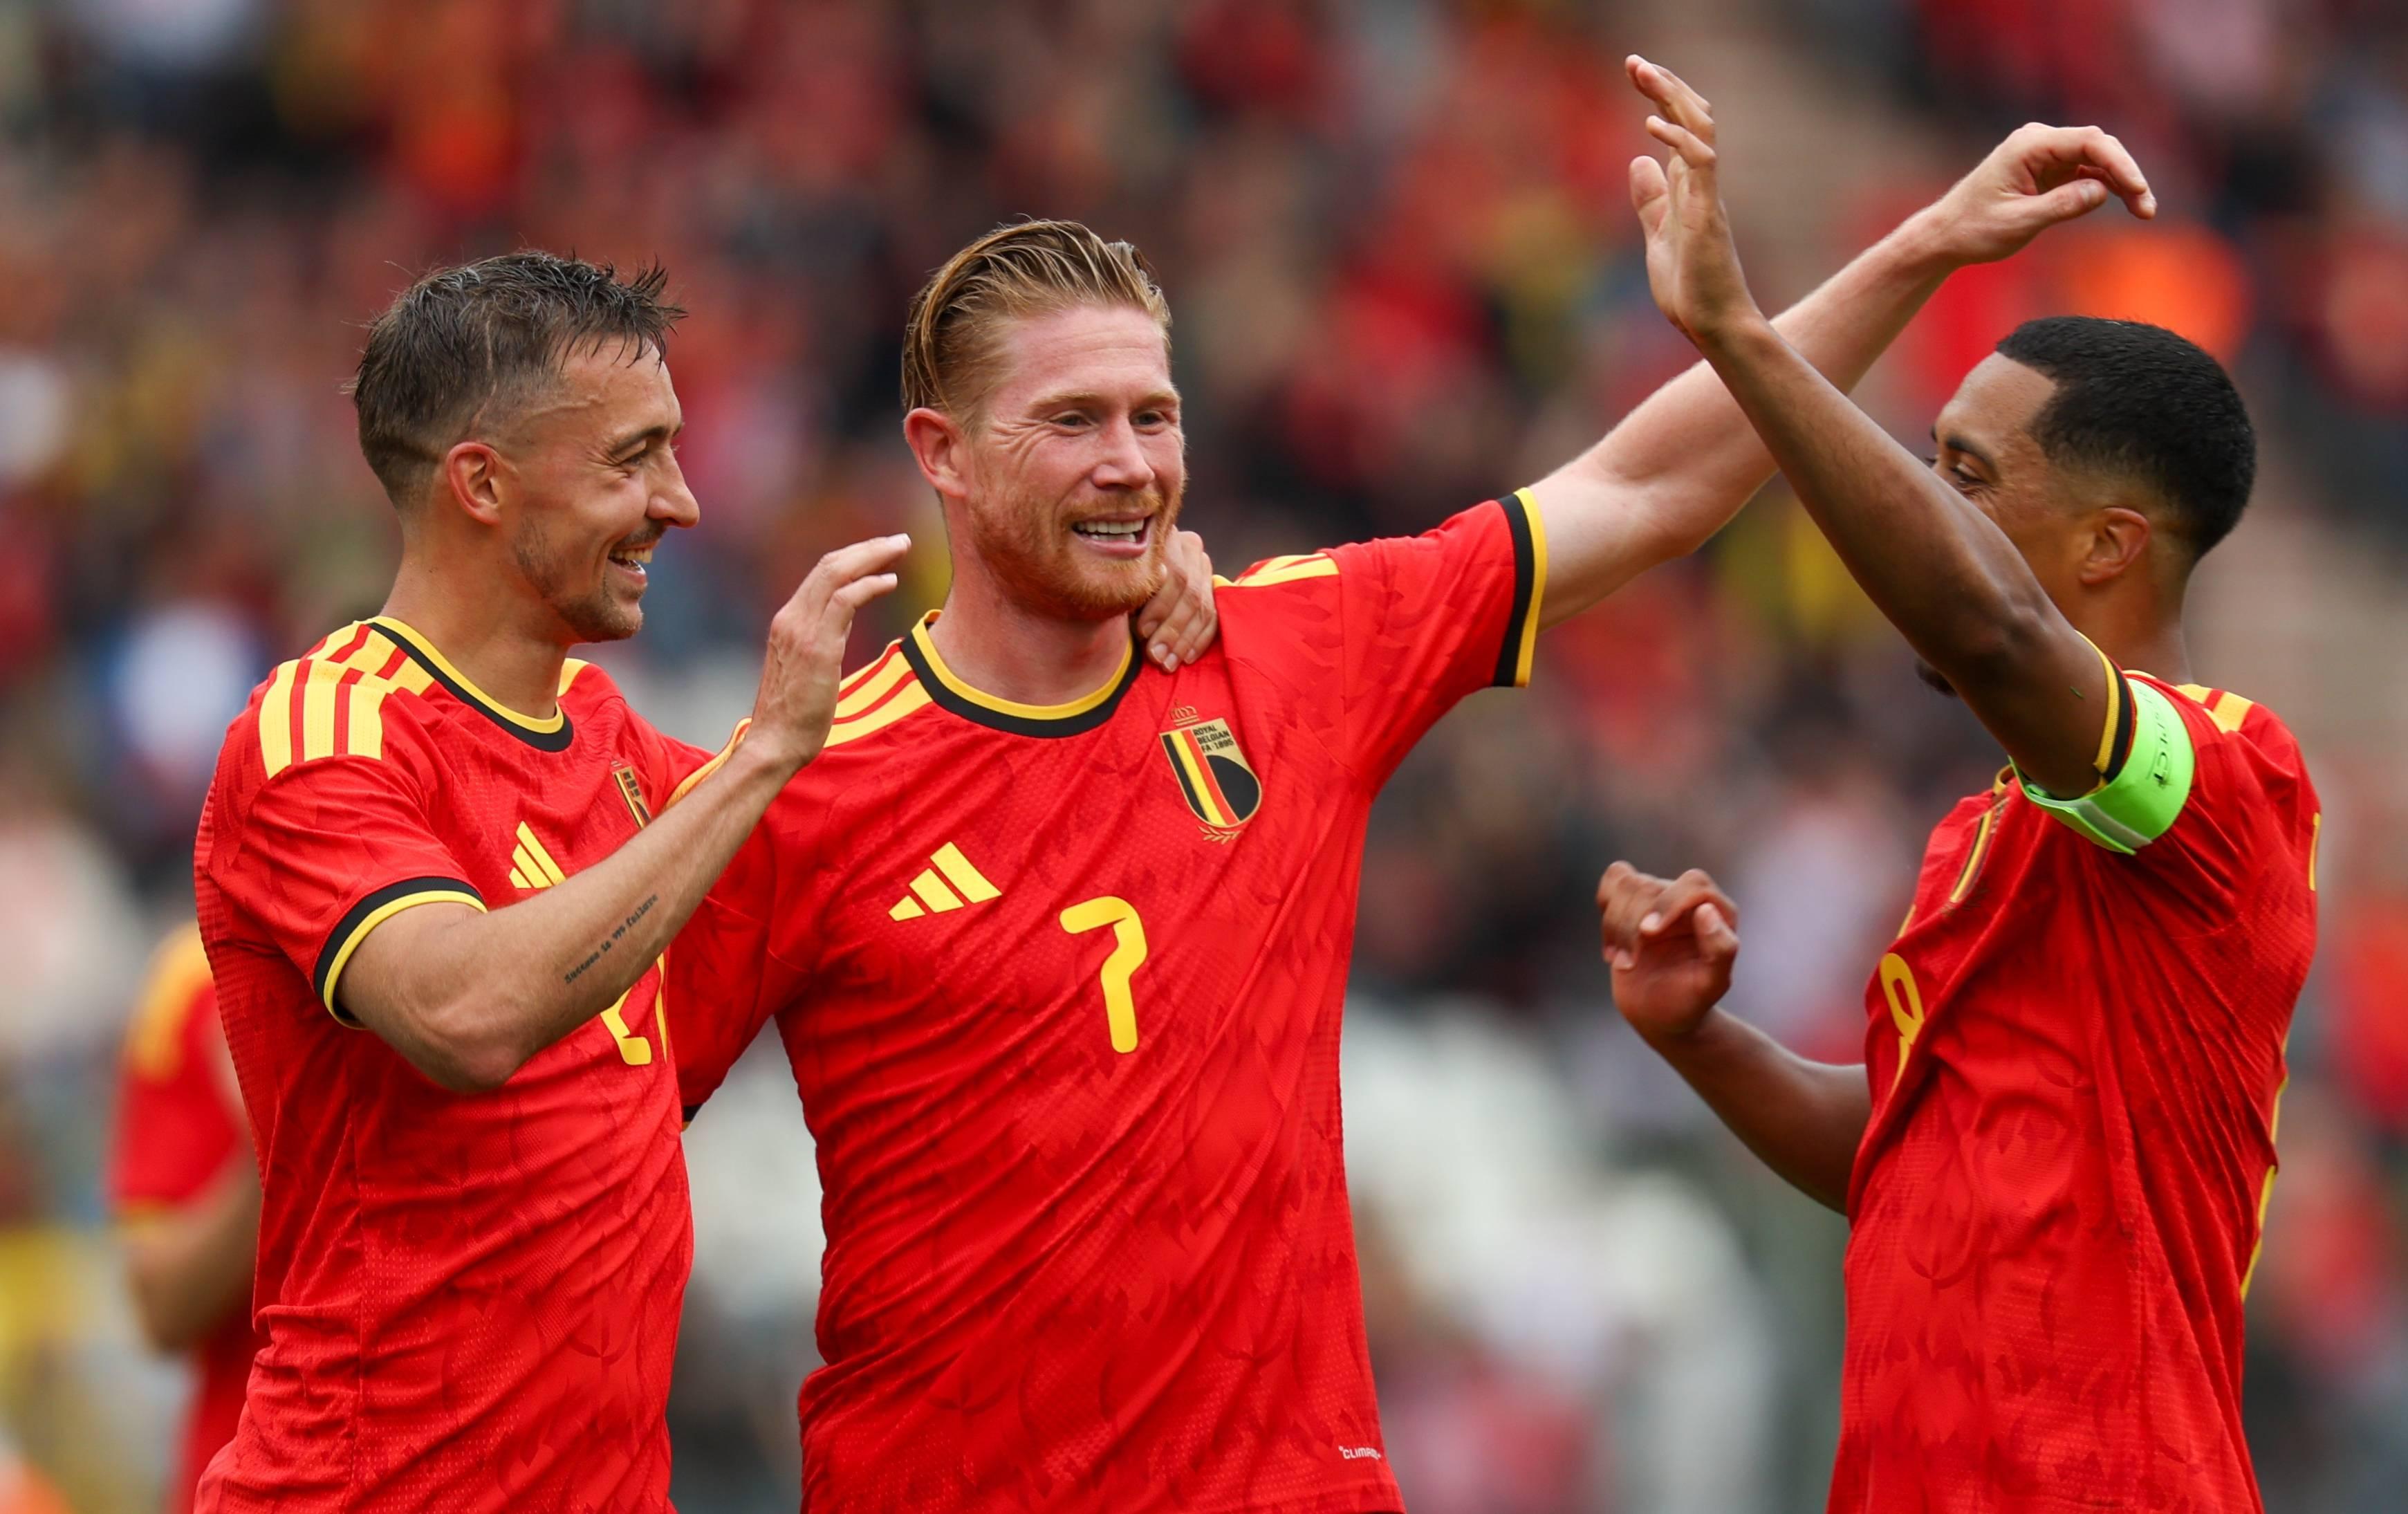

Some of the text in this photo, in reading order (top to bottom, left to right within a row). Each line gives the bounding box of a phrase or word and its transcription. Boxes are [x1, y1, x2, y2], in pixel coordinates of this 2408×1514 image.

[1193, 724, 1218, 737] ROYAL
[1197, 730, 1230, 744] BELGIAN
[1201, 744, 1212, 753] FA
[625, 894, 659, 927] failure
[1059, 896, 1147, 1053] 7
